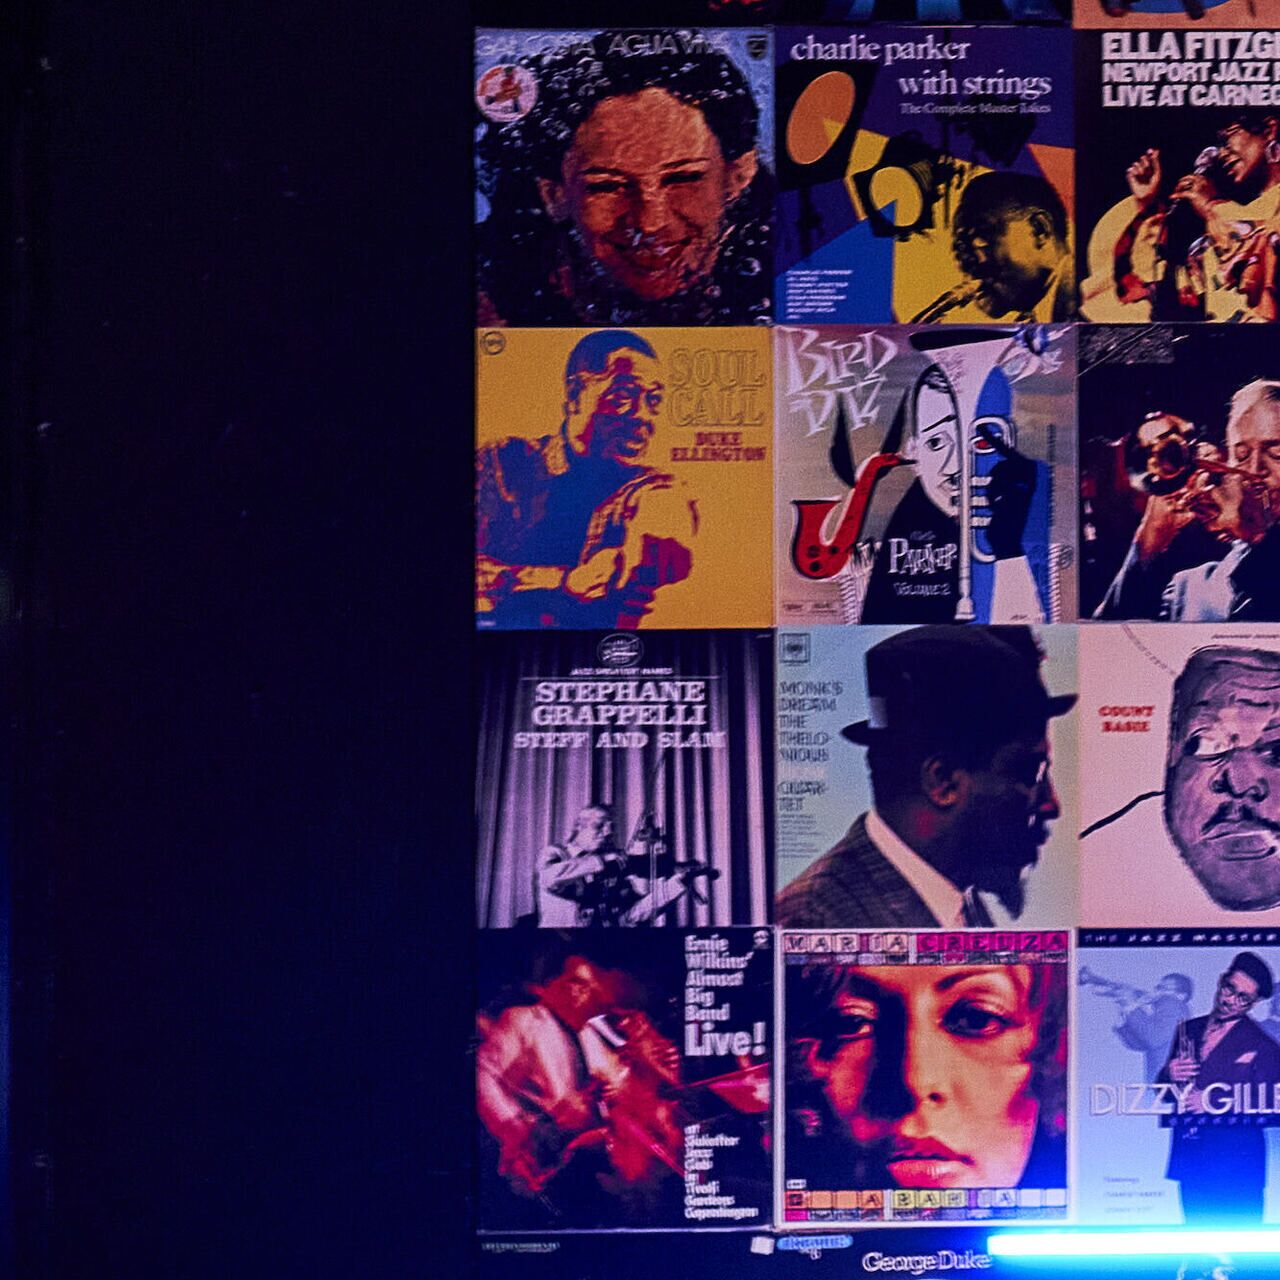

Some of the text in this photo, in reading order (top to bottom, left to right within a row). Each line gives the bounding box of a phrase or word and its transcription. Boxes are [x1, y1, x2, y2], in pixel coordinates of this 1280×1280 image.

[790, 35, 972, 65] charlie parker
[1102, 32, 1181, 59] ELLA
[1102, 62, 1211, 82] NEWPORT
[1211, 62, 1271, 82] JAZZ
[898, 70, 1053, 99] with strings
[1102, 85, 1155, 107] LIVE
[1157, 84, 1188, 106] AT
[668, 348, 767, 386] SOUL
[667, 386, 767, 427] CALL
[695, 432, 743, 446] DUKE
[670, 447, 767, 462] ELLINGTON
[535, 681, 706, 703] STEPHANE
[531, 704, 708, 726] GRAPPELLI
[1098, 704, 1156, 717] COUNT
[1102, 721, 1151, 732] BASIE
[513, 731, 728, 749] STEFF AND SLAM
[685, 1002, 731, 1021] Band
[685, 1021, 767, 1057] Live!
[1088, 1083, 1193, 1116] DIZZY
[862, 1249, 994, 1275] George Duke
